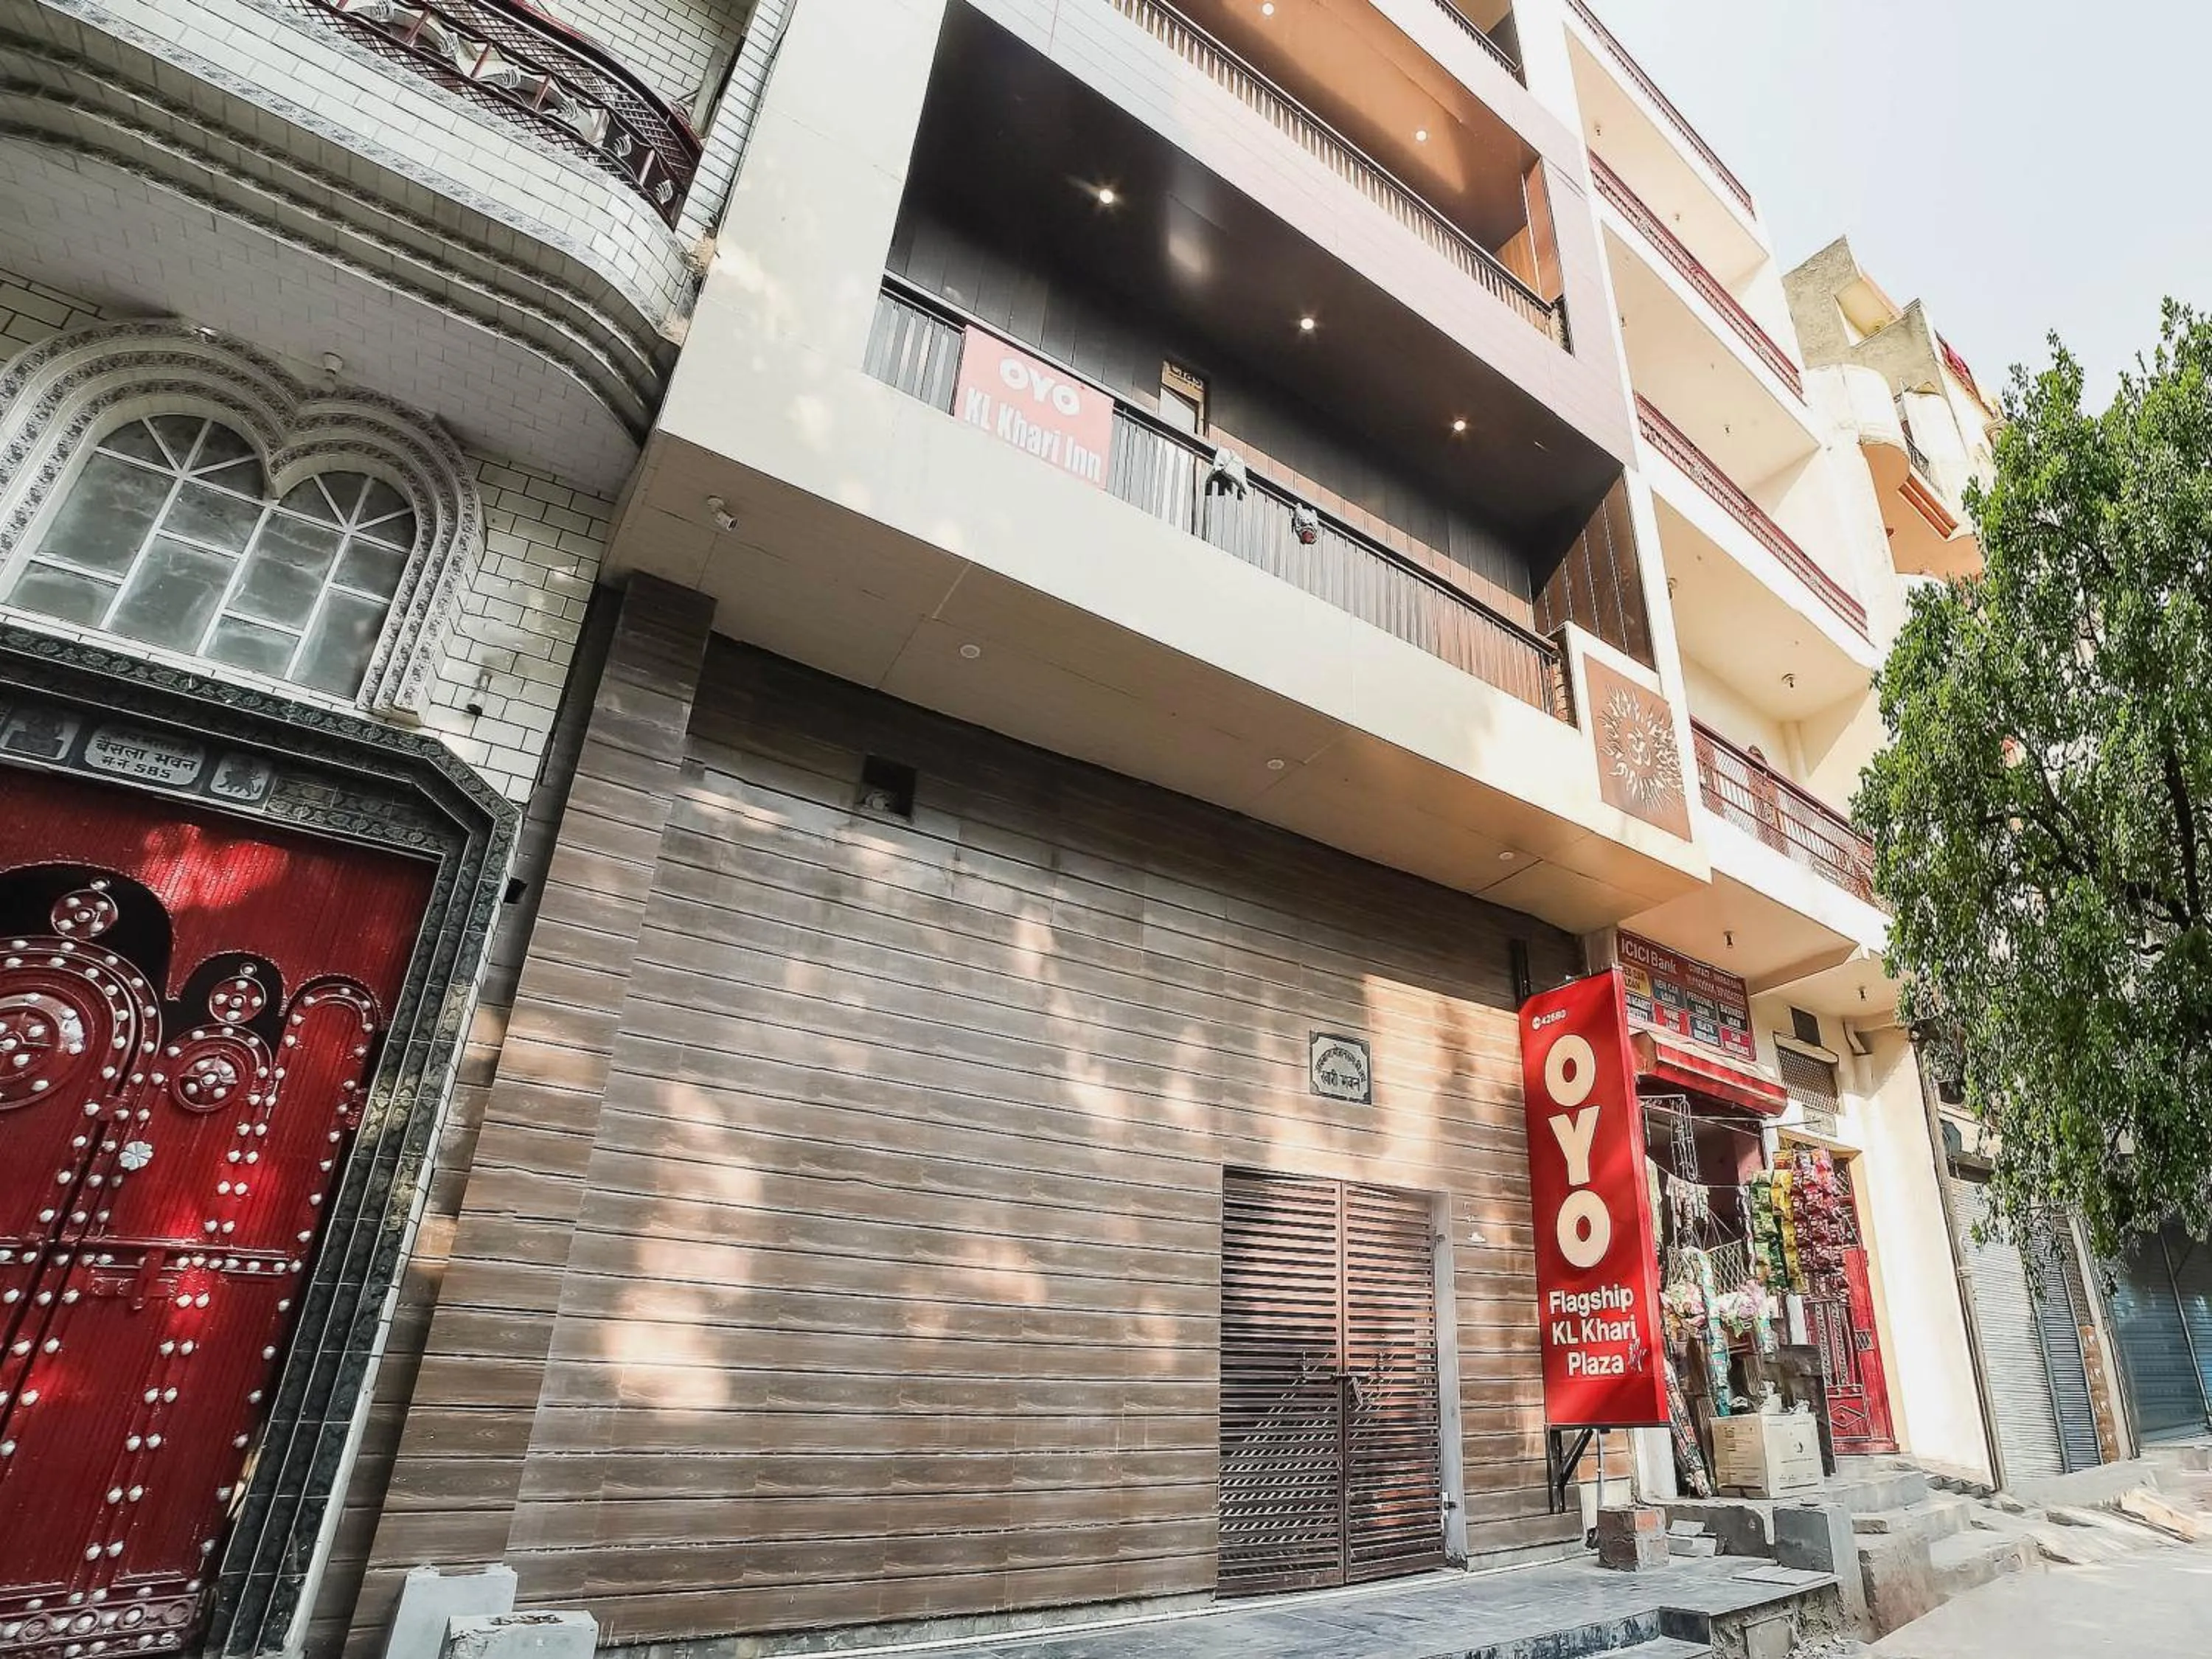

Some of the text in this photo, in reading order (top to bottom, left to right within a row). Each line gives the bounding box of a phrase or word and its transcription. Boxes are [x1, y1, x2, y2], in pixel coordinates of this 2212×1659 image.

[999, 357, 1081, 417] OYO
[964, 386, 1102, 484] KL Khari Inn
[1621, 937, 1650, 964] ICICI
[1650, 952, 1677, 975] Bank
[1545, 1034, 1611, 1268] OYO
[1549, 1283, 1635, 1318] Flagship
[1552, 1313, 1638, 1346] KL Khari
[1568, 1351, 1625, 1377] Plaza
